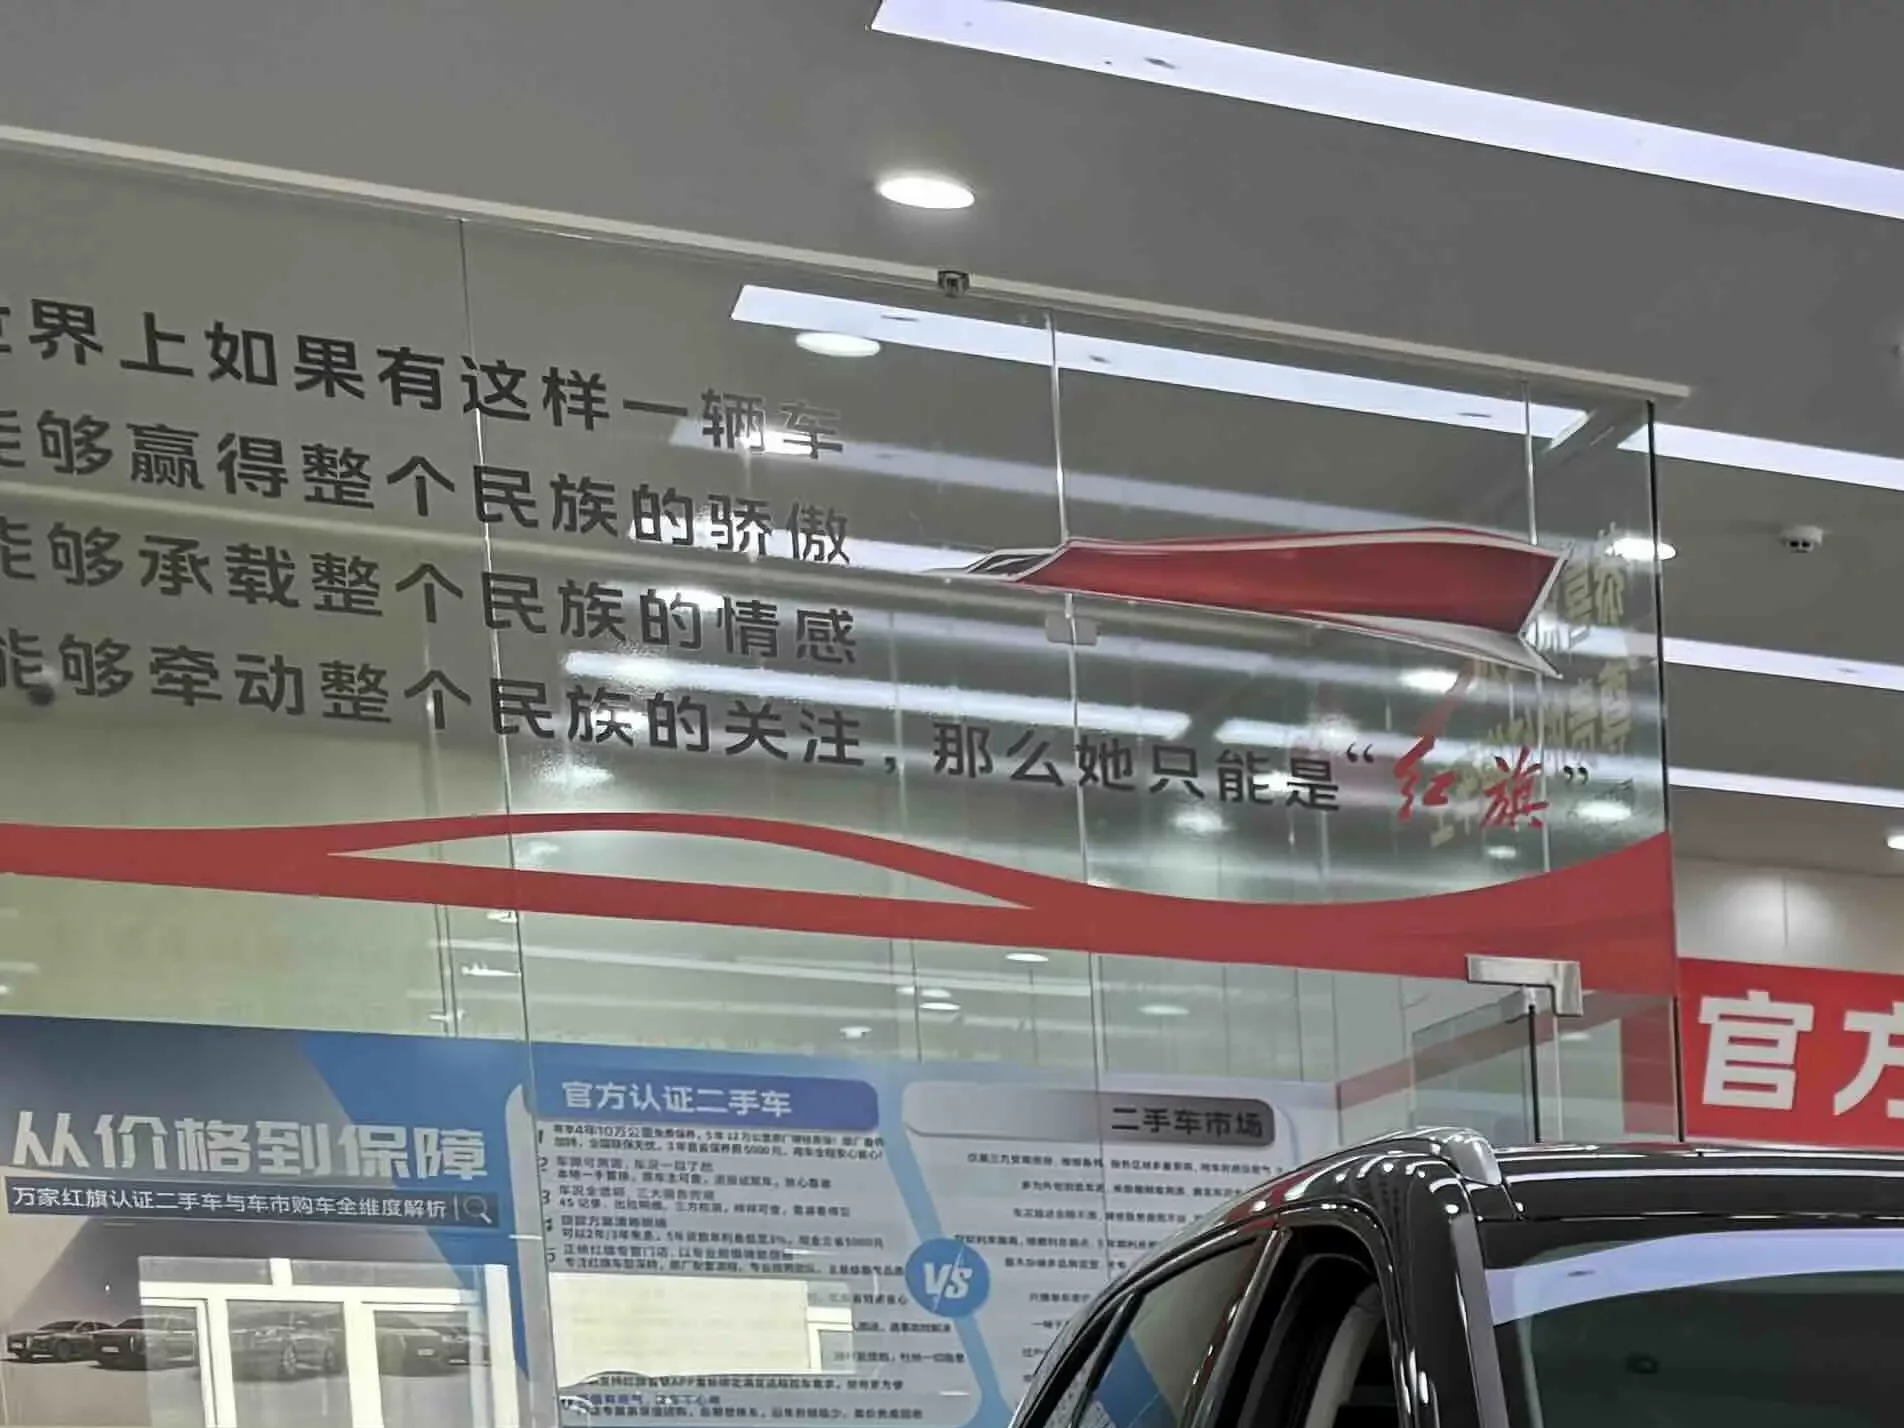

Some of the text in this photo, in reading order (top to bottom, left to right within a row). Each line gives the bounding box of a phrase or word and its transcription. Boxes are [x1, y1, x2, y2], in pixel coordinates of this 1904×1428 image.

[562, 1081, 793, 1118] 官方认证二手车
[1112, 1107, 1264, 1139] 二手车市场
[12, 1110, 488, 1182] 从价格到保障
[13, 1186, 447, 1221] 万家红旗认证二手车与车市购车全维度解析
[923, 1262, 973, 1300] VS
